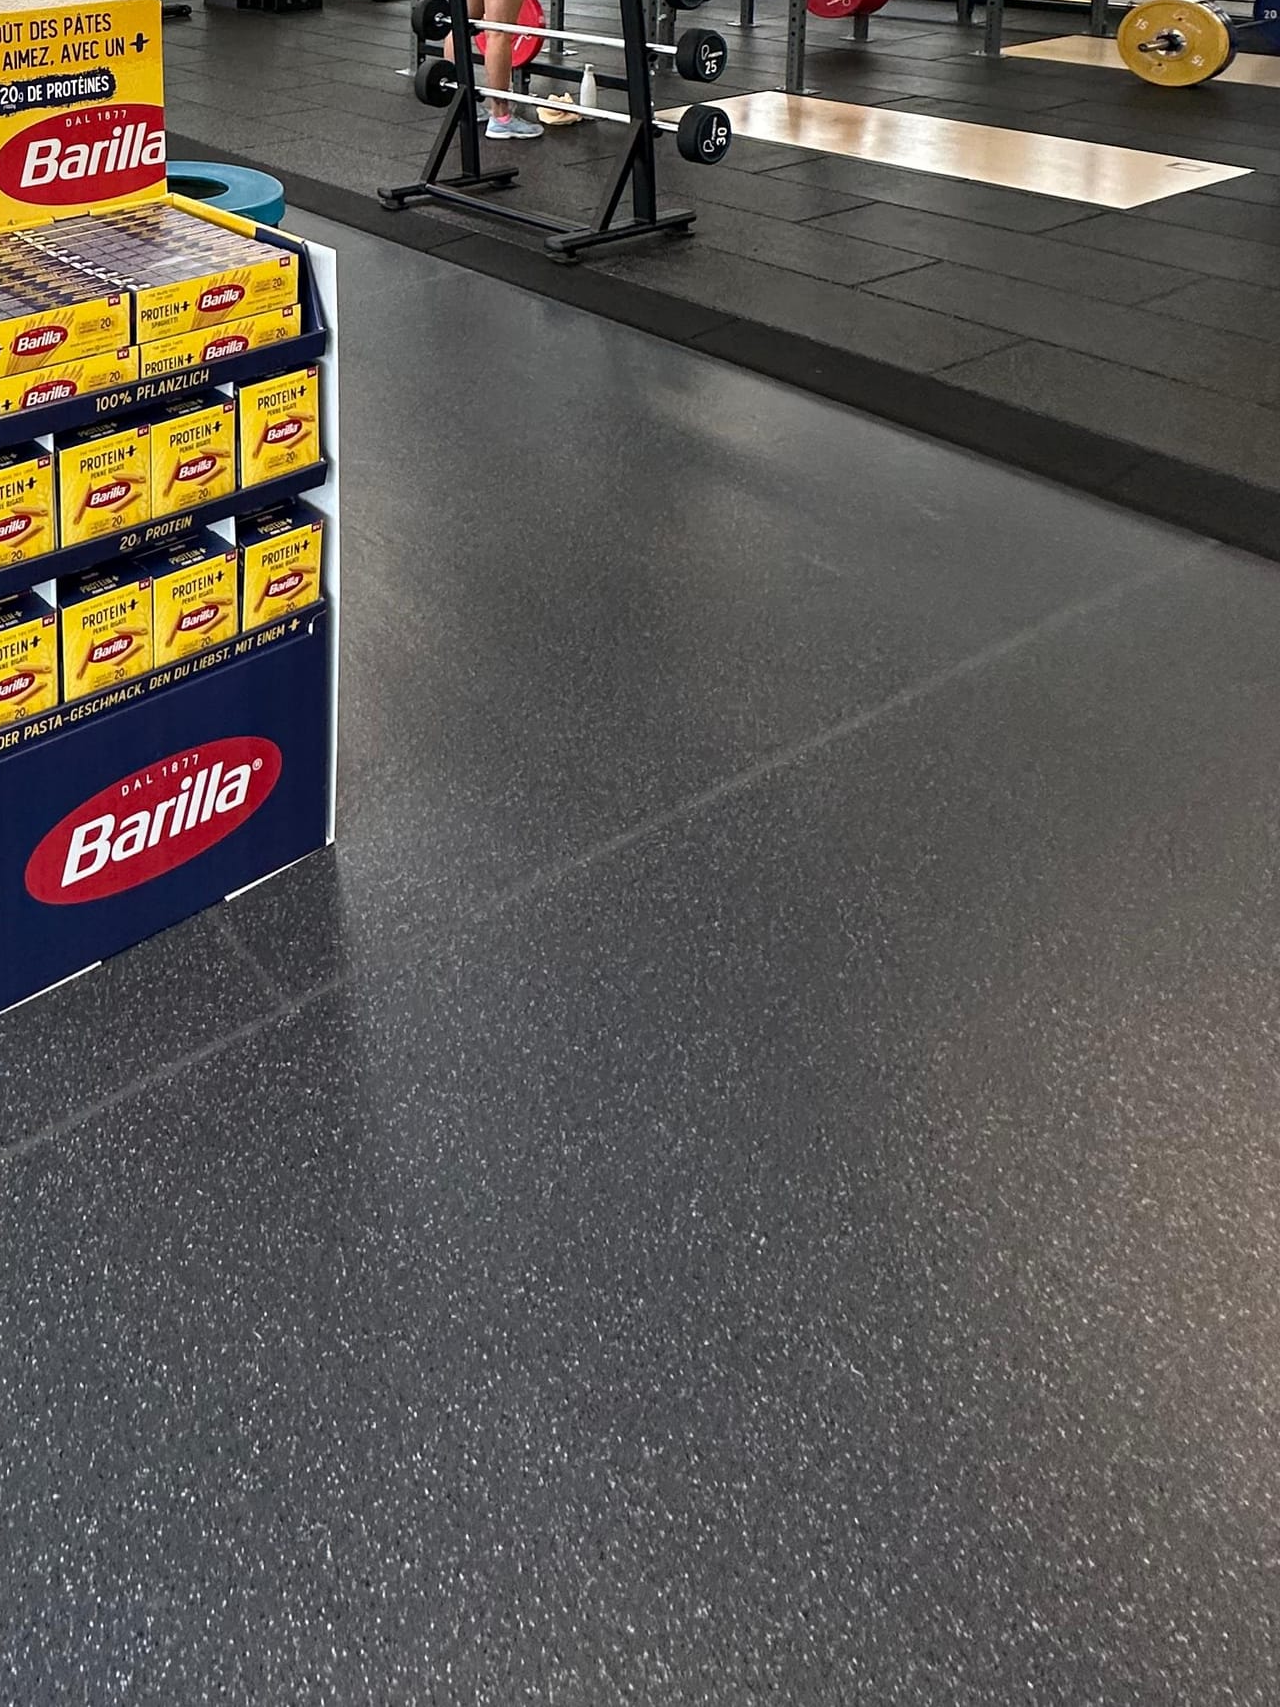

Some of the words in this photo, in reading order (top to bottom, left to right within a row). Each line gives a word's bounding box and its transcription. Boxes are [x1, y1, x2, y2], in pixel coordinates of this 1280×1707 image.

[1134, 18, 1149, 31] 15
[1263, 9, 1278, 20] 20
[29, 19, 58, 42] DES
[63, 12, 112, 36] PÂTES
[61, 40, 100, 64] AVEC
[105, 36, 126, 58] UN
[705, 59, 718, 75] 25
[0, 85, 24, 105] 20g
[27, 85, 43, 103] DE
[46, 75, 110, 100] PROTÉINES
[65, 115, 90, 128] DAL
[97, 109, 128, 122] 1877
[716, 127, 728, 146] 30
[20, 122, 166, 188] Barilla
[201, 289, 242, 309] Barilla
[140, 300, 191, 322] PROTEIN+
[16, 330, 63, 353] Barilla
[205, 341, 246, 361] Barilla
[145, 353, 195, 376] PROTEIN+
[25, 385, 72, 407] Barilla
[95, 390, 133, 413] 100%
[136, 367, 210, 402] PFLANZLICH
[257, 384, 308, 411] PROTEIN+
[169, 420, 223, 448] PROTEIN+
[266, 421, 300, 441] Barilla
[79, 444, 138, 474] PROTEIN+
[178, 458, 215, 480] Barilla
[90, 485, 127, 506] Barilla
[145, 514, 193, 543] PROTEIN
[261, 539, 311, 567] PROTEIN+
[172, 570, 225, 600] PROTEIN+
[268, 575, 301, 596] Barilla
[82, 598, 140, 630] PROTEIN+
[181, 607, 217, 630] Barilla
[92, 637, 128, 661] Barilla
[149, 670, 171, 691] DEN
[174, 662, 191, 682] DU
[234, 637, 253, 656] MIT
[256, 624, 286, 646] EINEM
[121, 774, 154, 797] DAL
[161, 753, 200, 777] 1877
